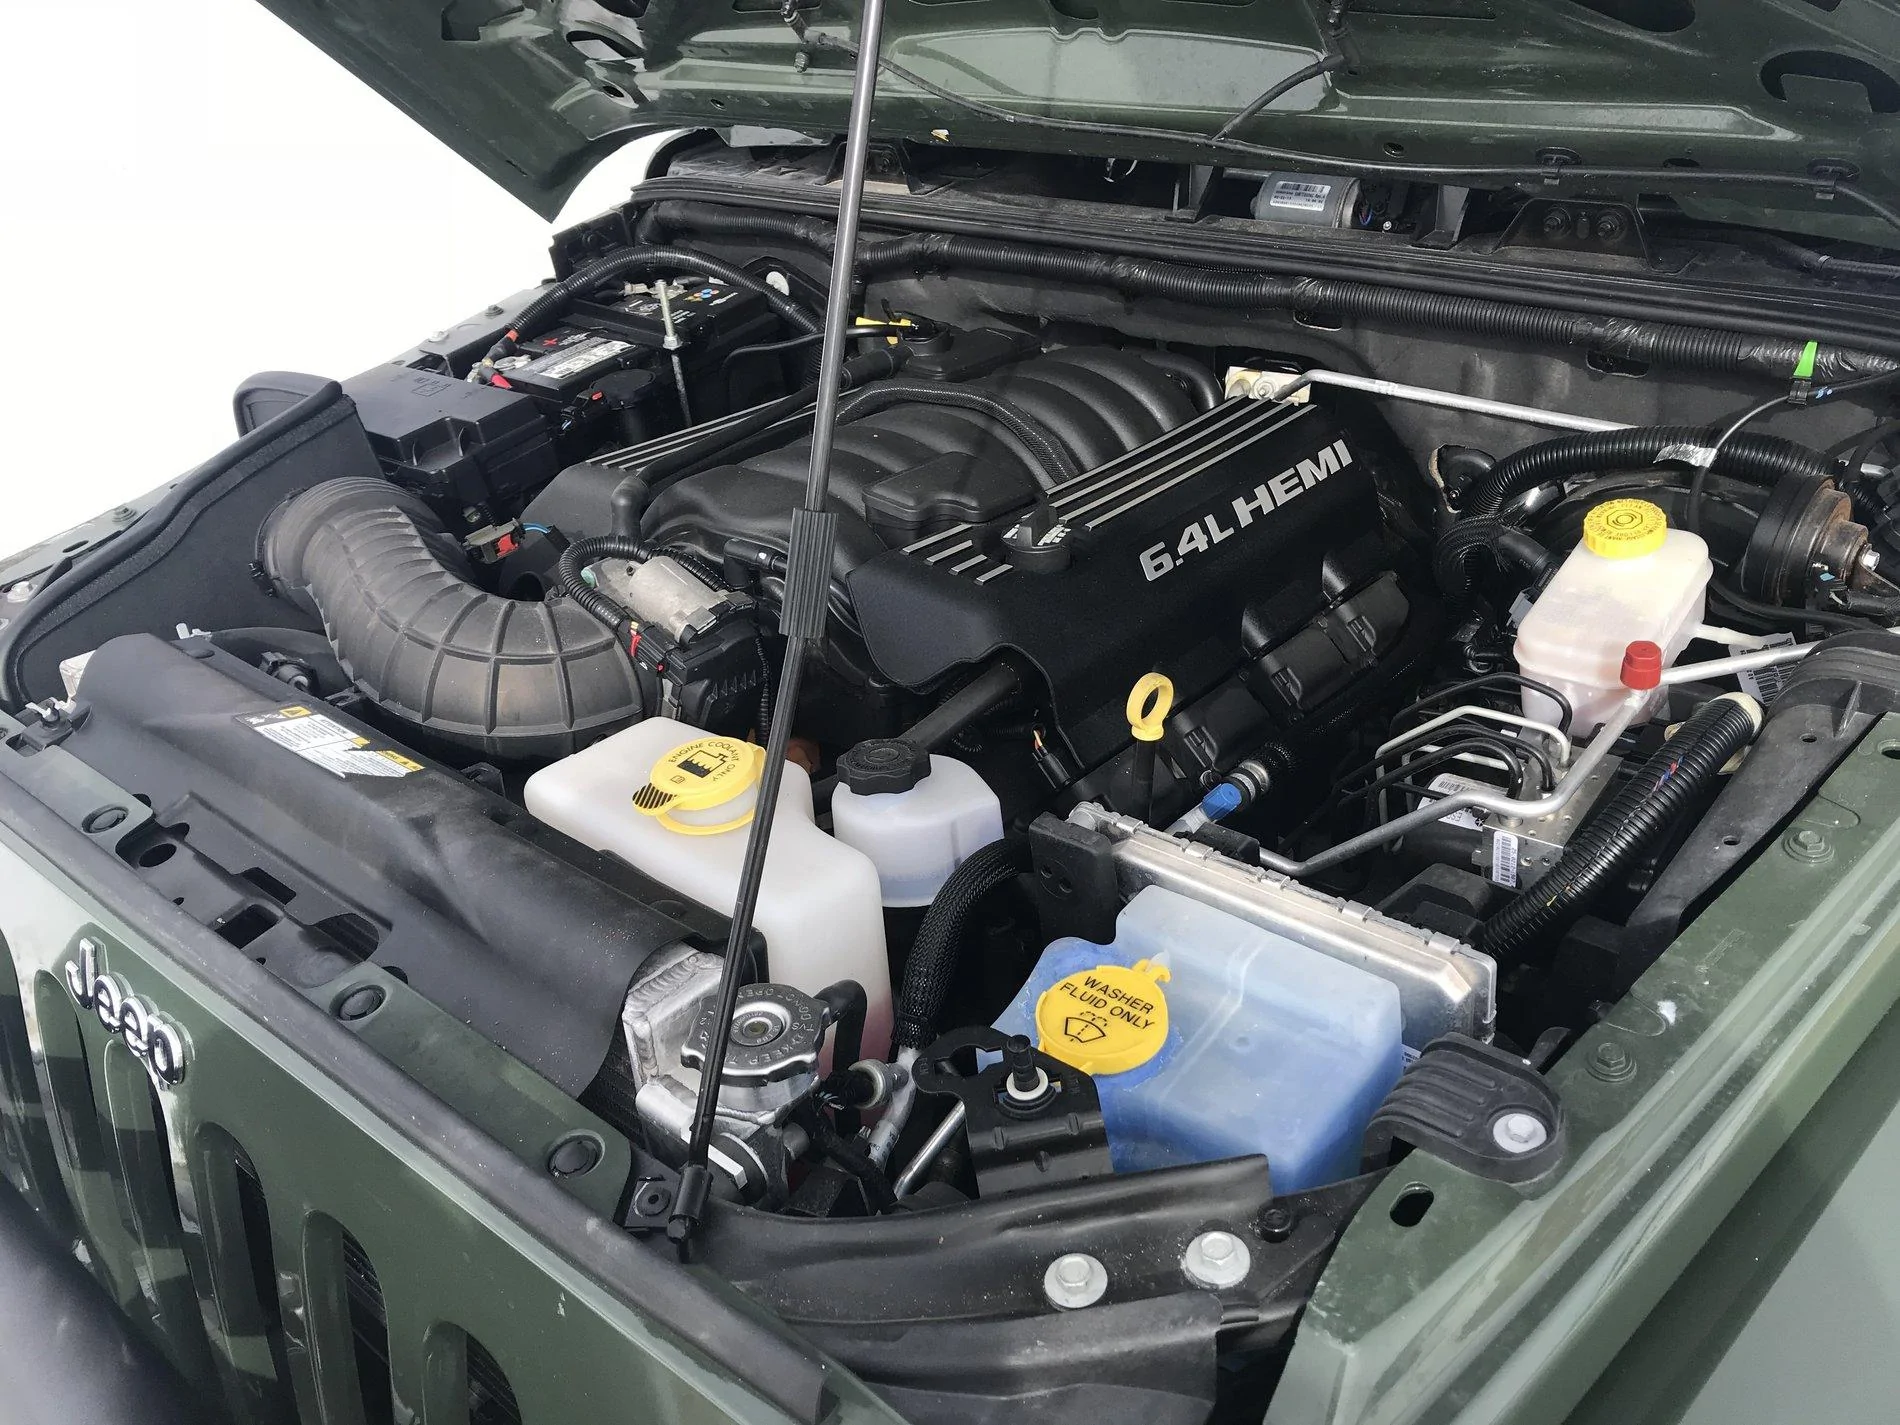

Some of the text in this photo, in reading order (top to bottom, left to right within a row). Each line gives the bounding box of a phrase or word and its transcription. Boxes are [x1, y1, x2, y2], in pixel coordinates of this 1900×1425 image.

[1139, 438, 1353, 582] 6.4L HEMI
[668, 741, 740, 782] ENGINE COOLANT ONLY
[64, 937, 186, 1089] Jeep
[1059, 981, 1156, 1030] FLUID ONLY
[1084, 975, 1155, 1015] WASHER
